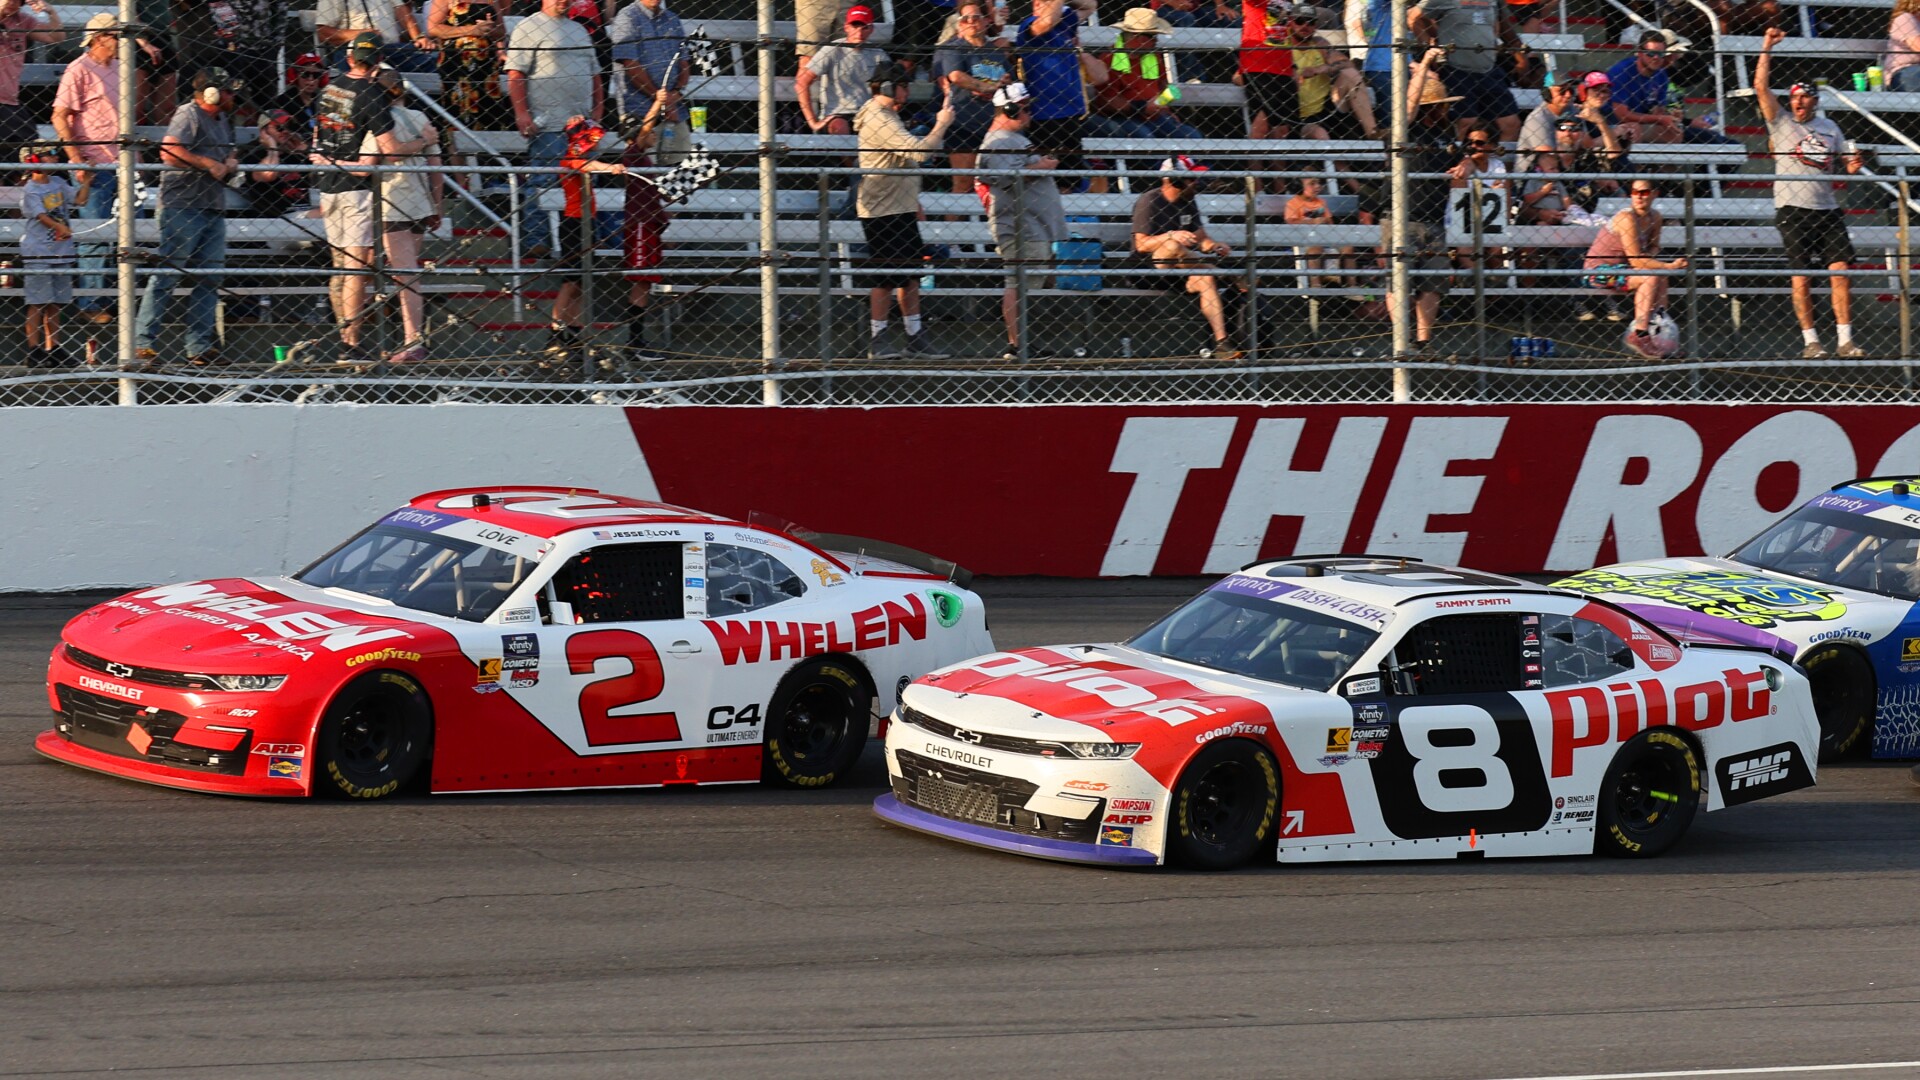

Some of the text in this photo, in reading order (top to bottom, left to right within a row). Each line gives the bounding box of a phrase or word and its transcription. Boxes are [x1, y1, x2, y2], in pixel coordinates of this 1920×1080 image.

[1455, 193, 1503, 233] 12
[1100, 416, 1509, 576] THE
[1816, 495, 1870, 512] xfinity
[389, 509, 442, 528] xfinity
[477, 528, 520, 546] LOVE
[1225, 575, 1282, 595] xfinity
[1435, 598, 1511, 608] SAMMY SMITH
[133, 582, 409, 651] WHELEN
[224, 622, 249, 632] IN
[700, 592, 927, 666] WHELEN
[1809, 627, 1872, 644] GOODYEAR
[509, 640, 533, 652] xfinity
[345, 648, 421, 668] GOODYEAR
[503, 658, 538, 668] COMETIC
[79, 676, 143, 700] CHEVROLET
[510, 679, 534, 689] MSD
[565, 629, 682, 747] 2
[969, 652, 1215, 727] pilot
[707, 704, 761, 730] C4
[1359, 710, 1383, 721] xfinity
[1543, 667, 1771, 778] pilot
[707, 730, 760, 743] ULTIMATE ENERGY
[1195, 721, 1268, 744] GOODYEAR
[1352, 729, 1389, 738] COMETIC
[254, 745, 304, 755] ARP
[926, 743, 994, 768] CHEVROLET
[1355, 751, 1378, 759] MSD
[1399, 704, 1514, 812] 8
[270, 764, 300, 772] SUNOCO
[1728, 750, 1791, 791] TMC
[1111, 800, 1151, 811] SIMPSON
[1567, 795, 1595, 804] SINCLAIR
[1104, 814, 1152, 824] ARP
[1564, 811, 1595, 819] RENDA
[1102, 831, 1132, 840] SUNOCO
[1610, 824, 1642, 852] EAGLE
